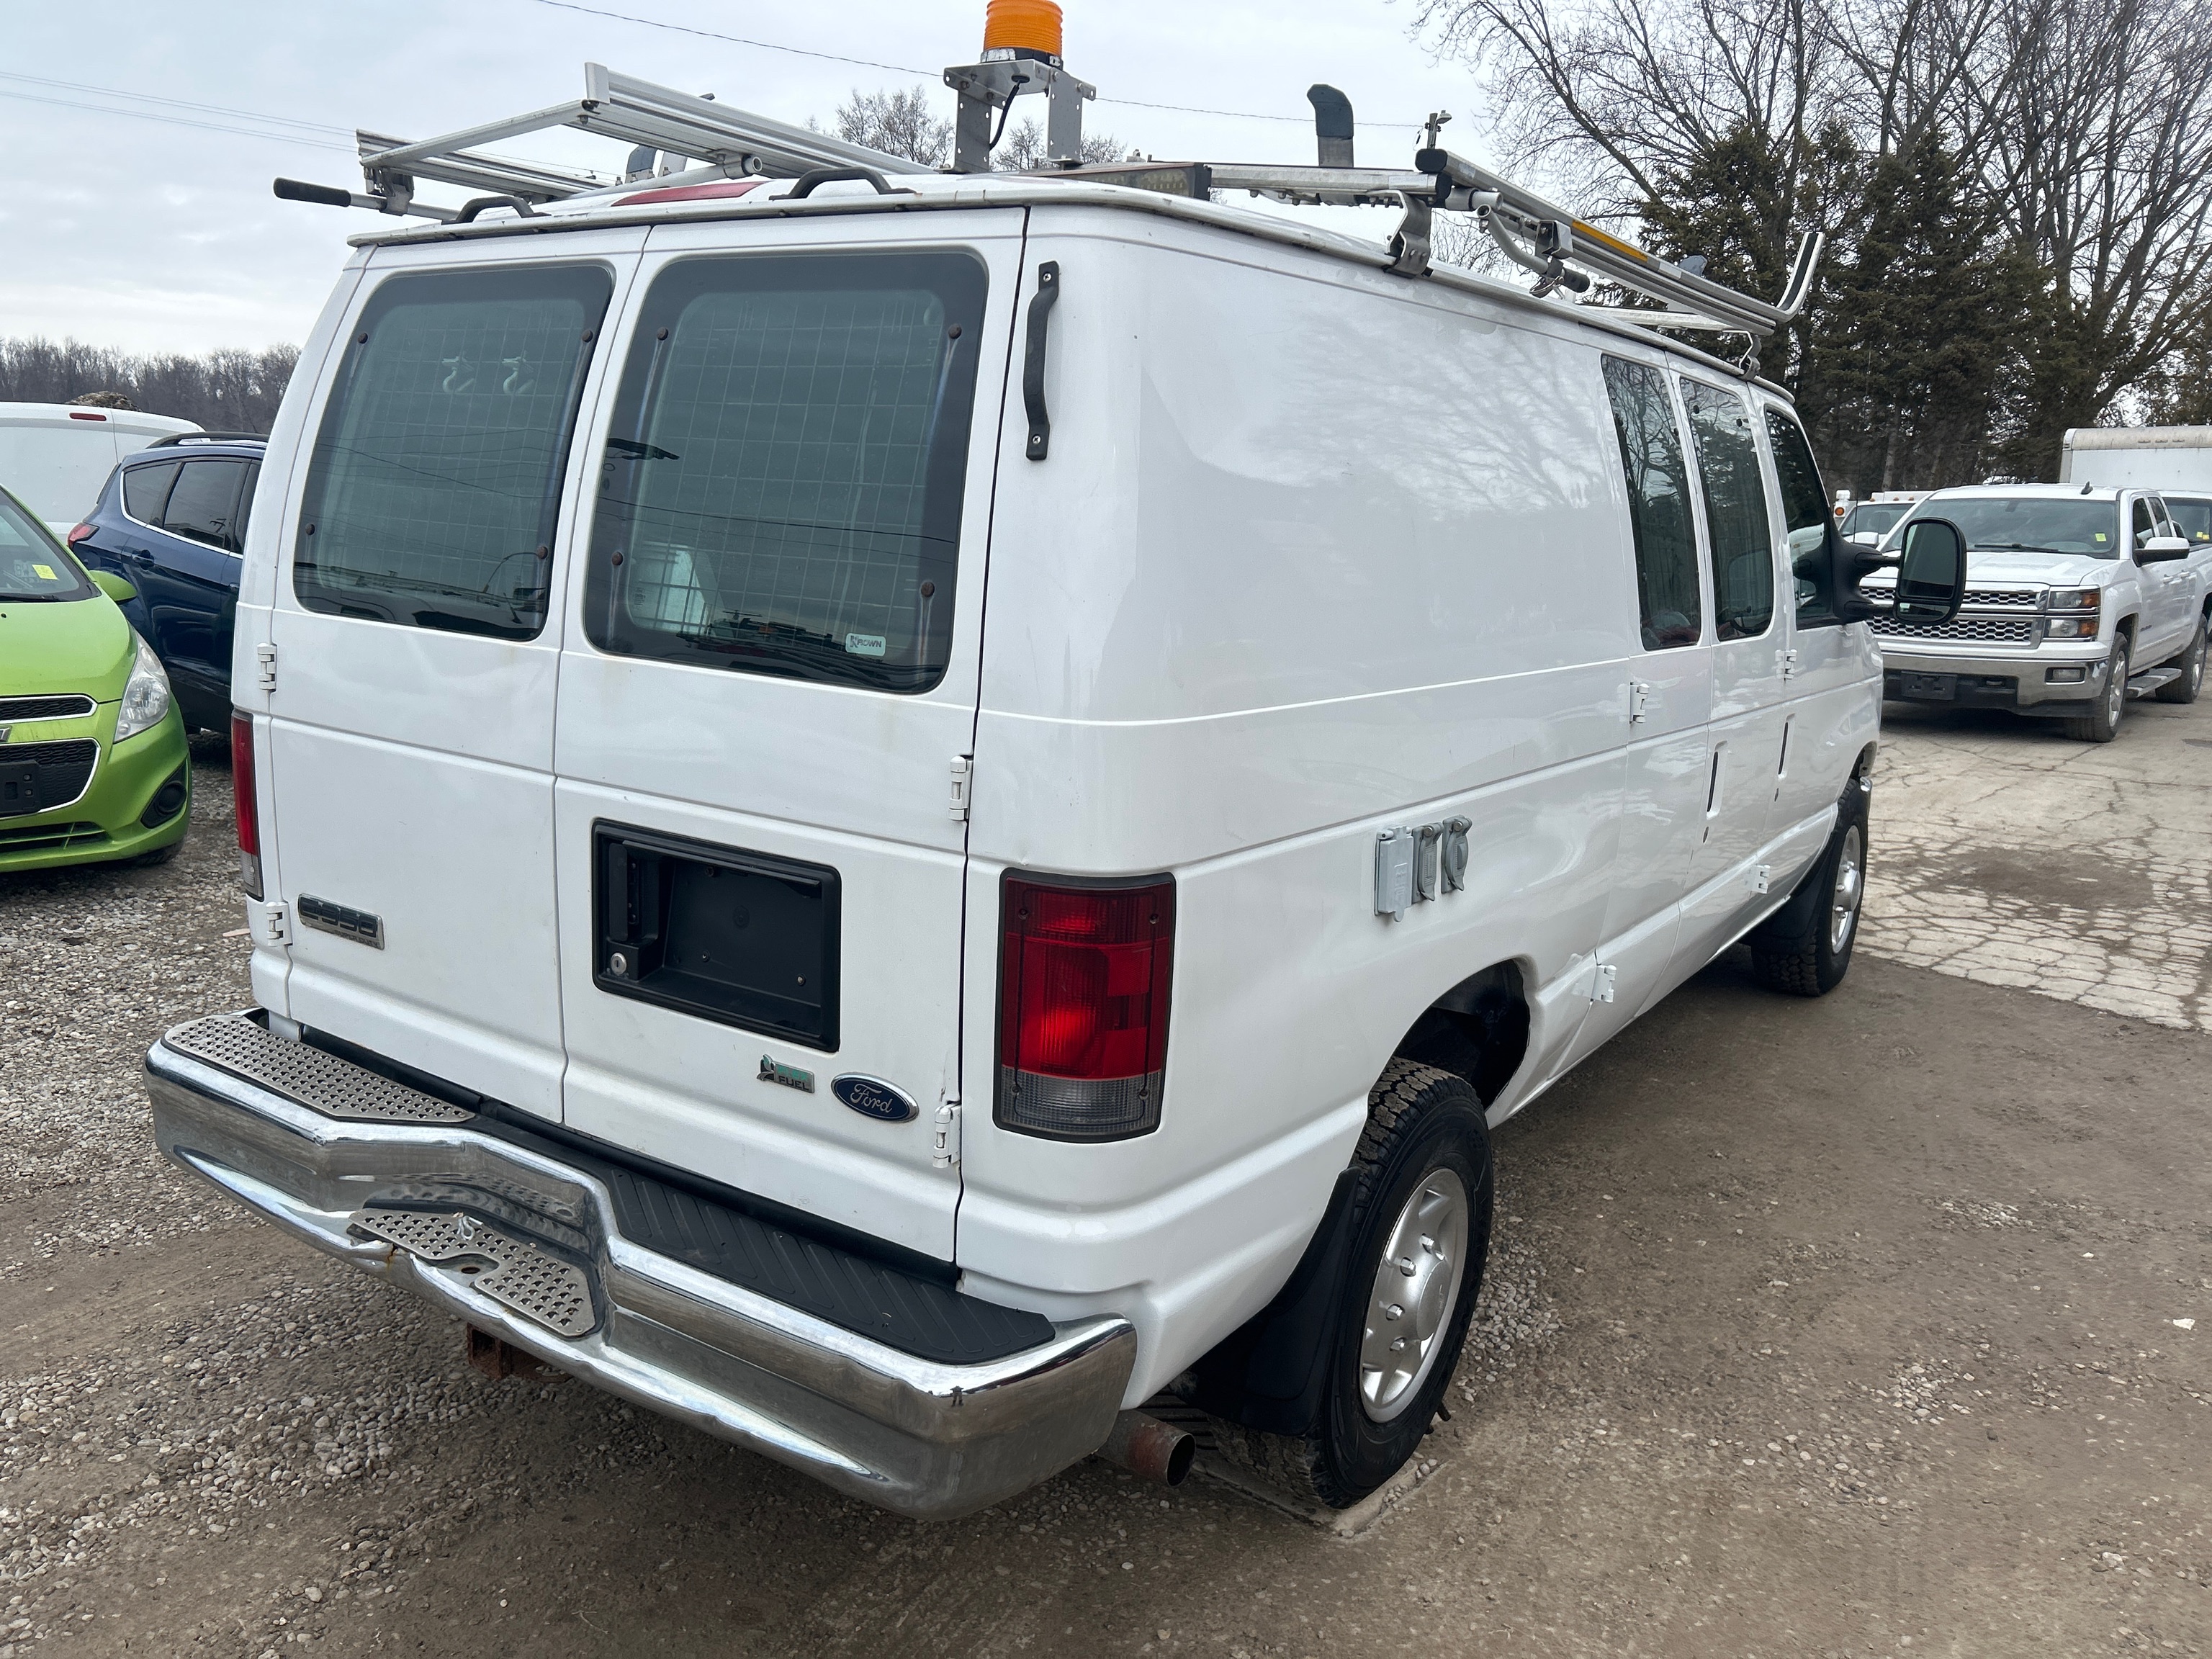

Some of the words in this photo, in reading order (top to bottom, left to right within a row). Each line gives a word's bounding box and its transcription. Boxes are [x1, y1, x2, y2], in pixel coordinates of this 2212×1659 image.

[850, 635, 882, 648] KROWN
[778, 1075, 809, 1092] FUEL
[850, 1083, 893, 1113] Ford
